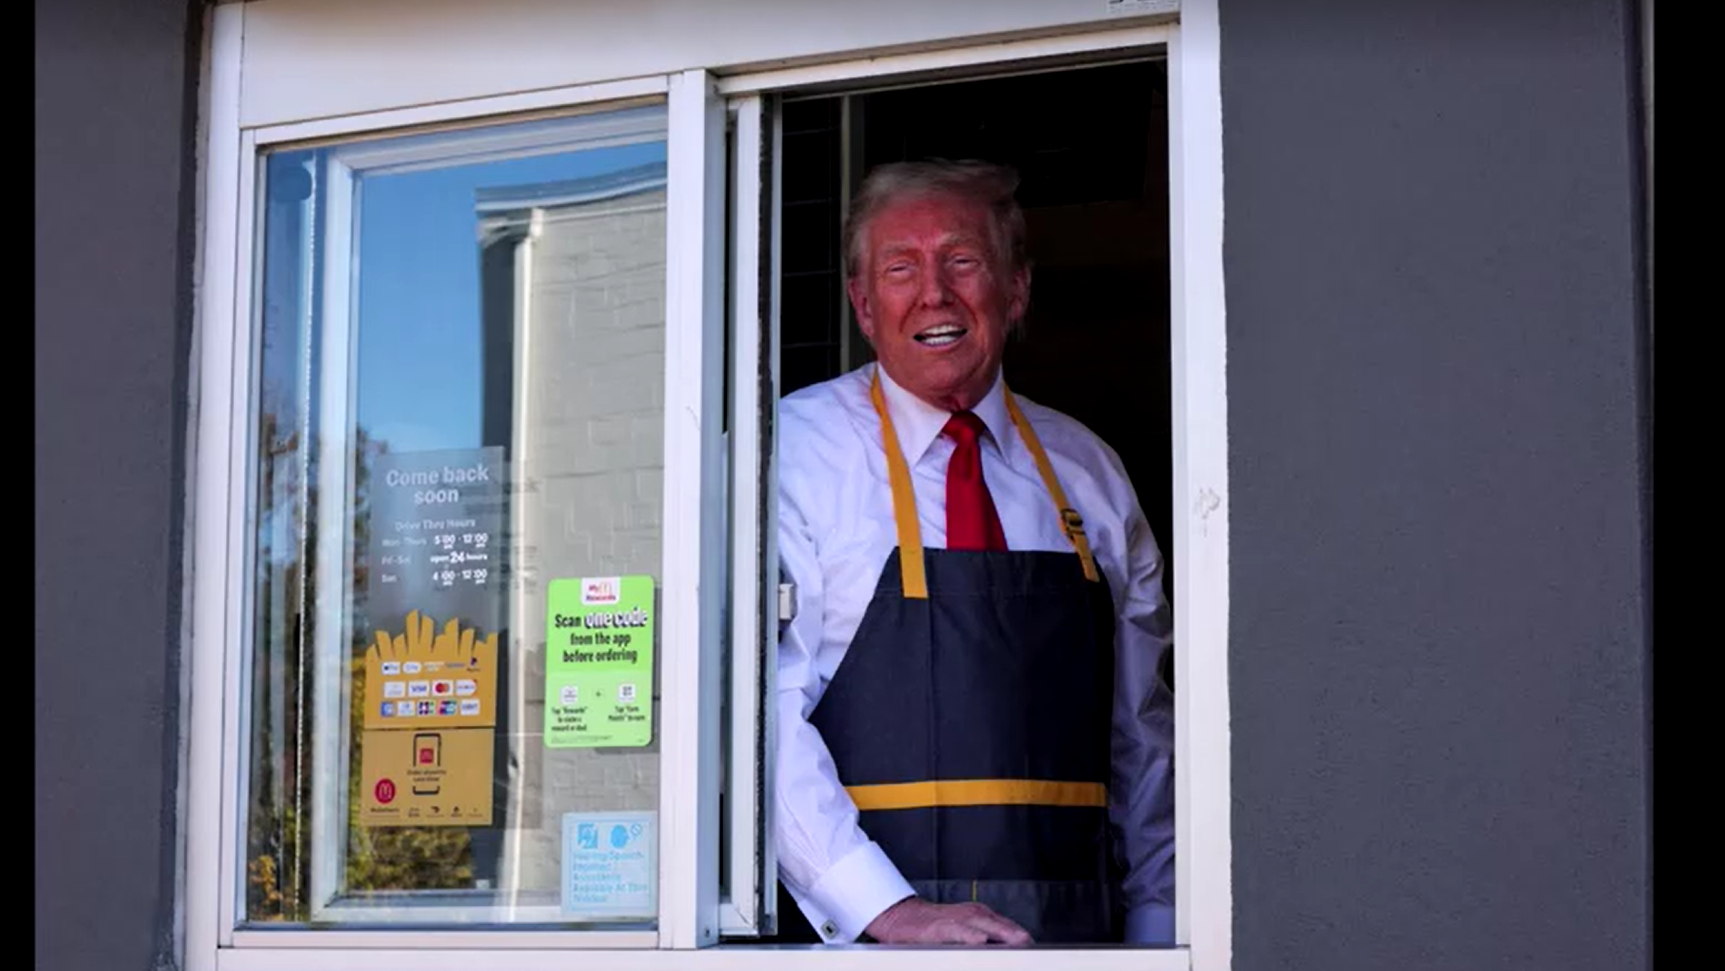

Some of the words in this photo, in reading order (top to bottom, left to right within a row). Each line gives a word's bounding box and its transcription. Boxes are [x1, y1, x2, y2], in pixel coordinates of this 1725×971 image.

[386, 469, 439, 487] Come
[443, 463, 489, 483] back
[414, 488, 459, 505] soon
[450, 551, 465, 563] 24
[555, 613, 581, 628] Scan
[585, 611, 612, 629] one
[613, 605, 648, 628] code
[571, 632, 593, 646] from
[595, 631, 611, 645] the
[613, 633, 632, 648] app
[563, 649, 594, 663] before
[596, 646, 638, 664] ordering
